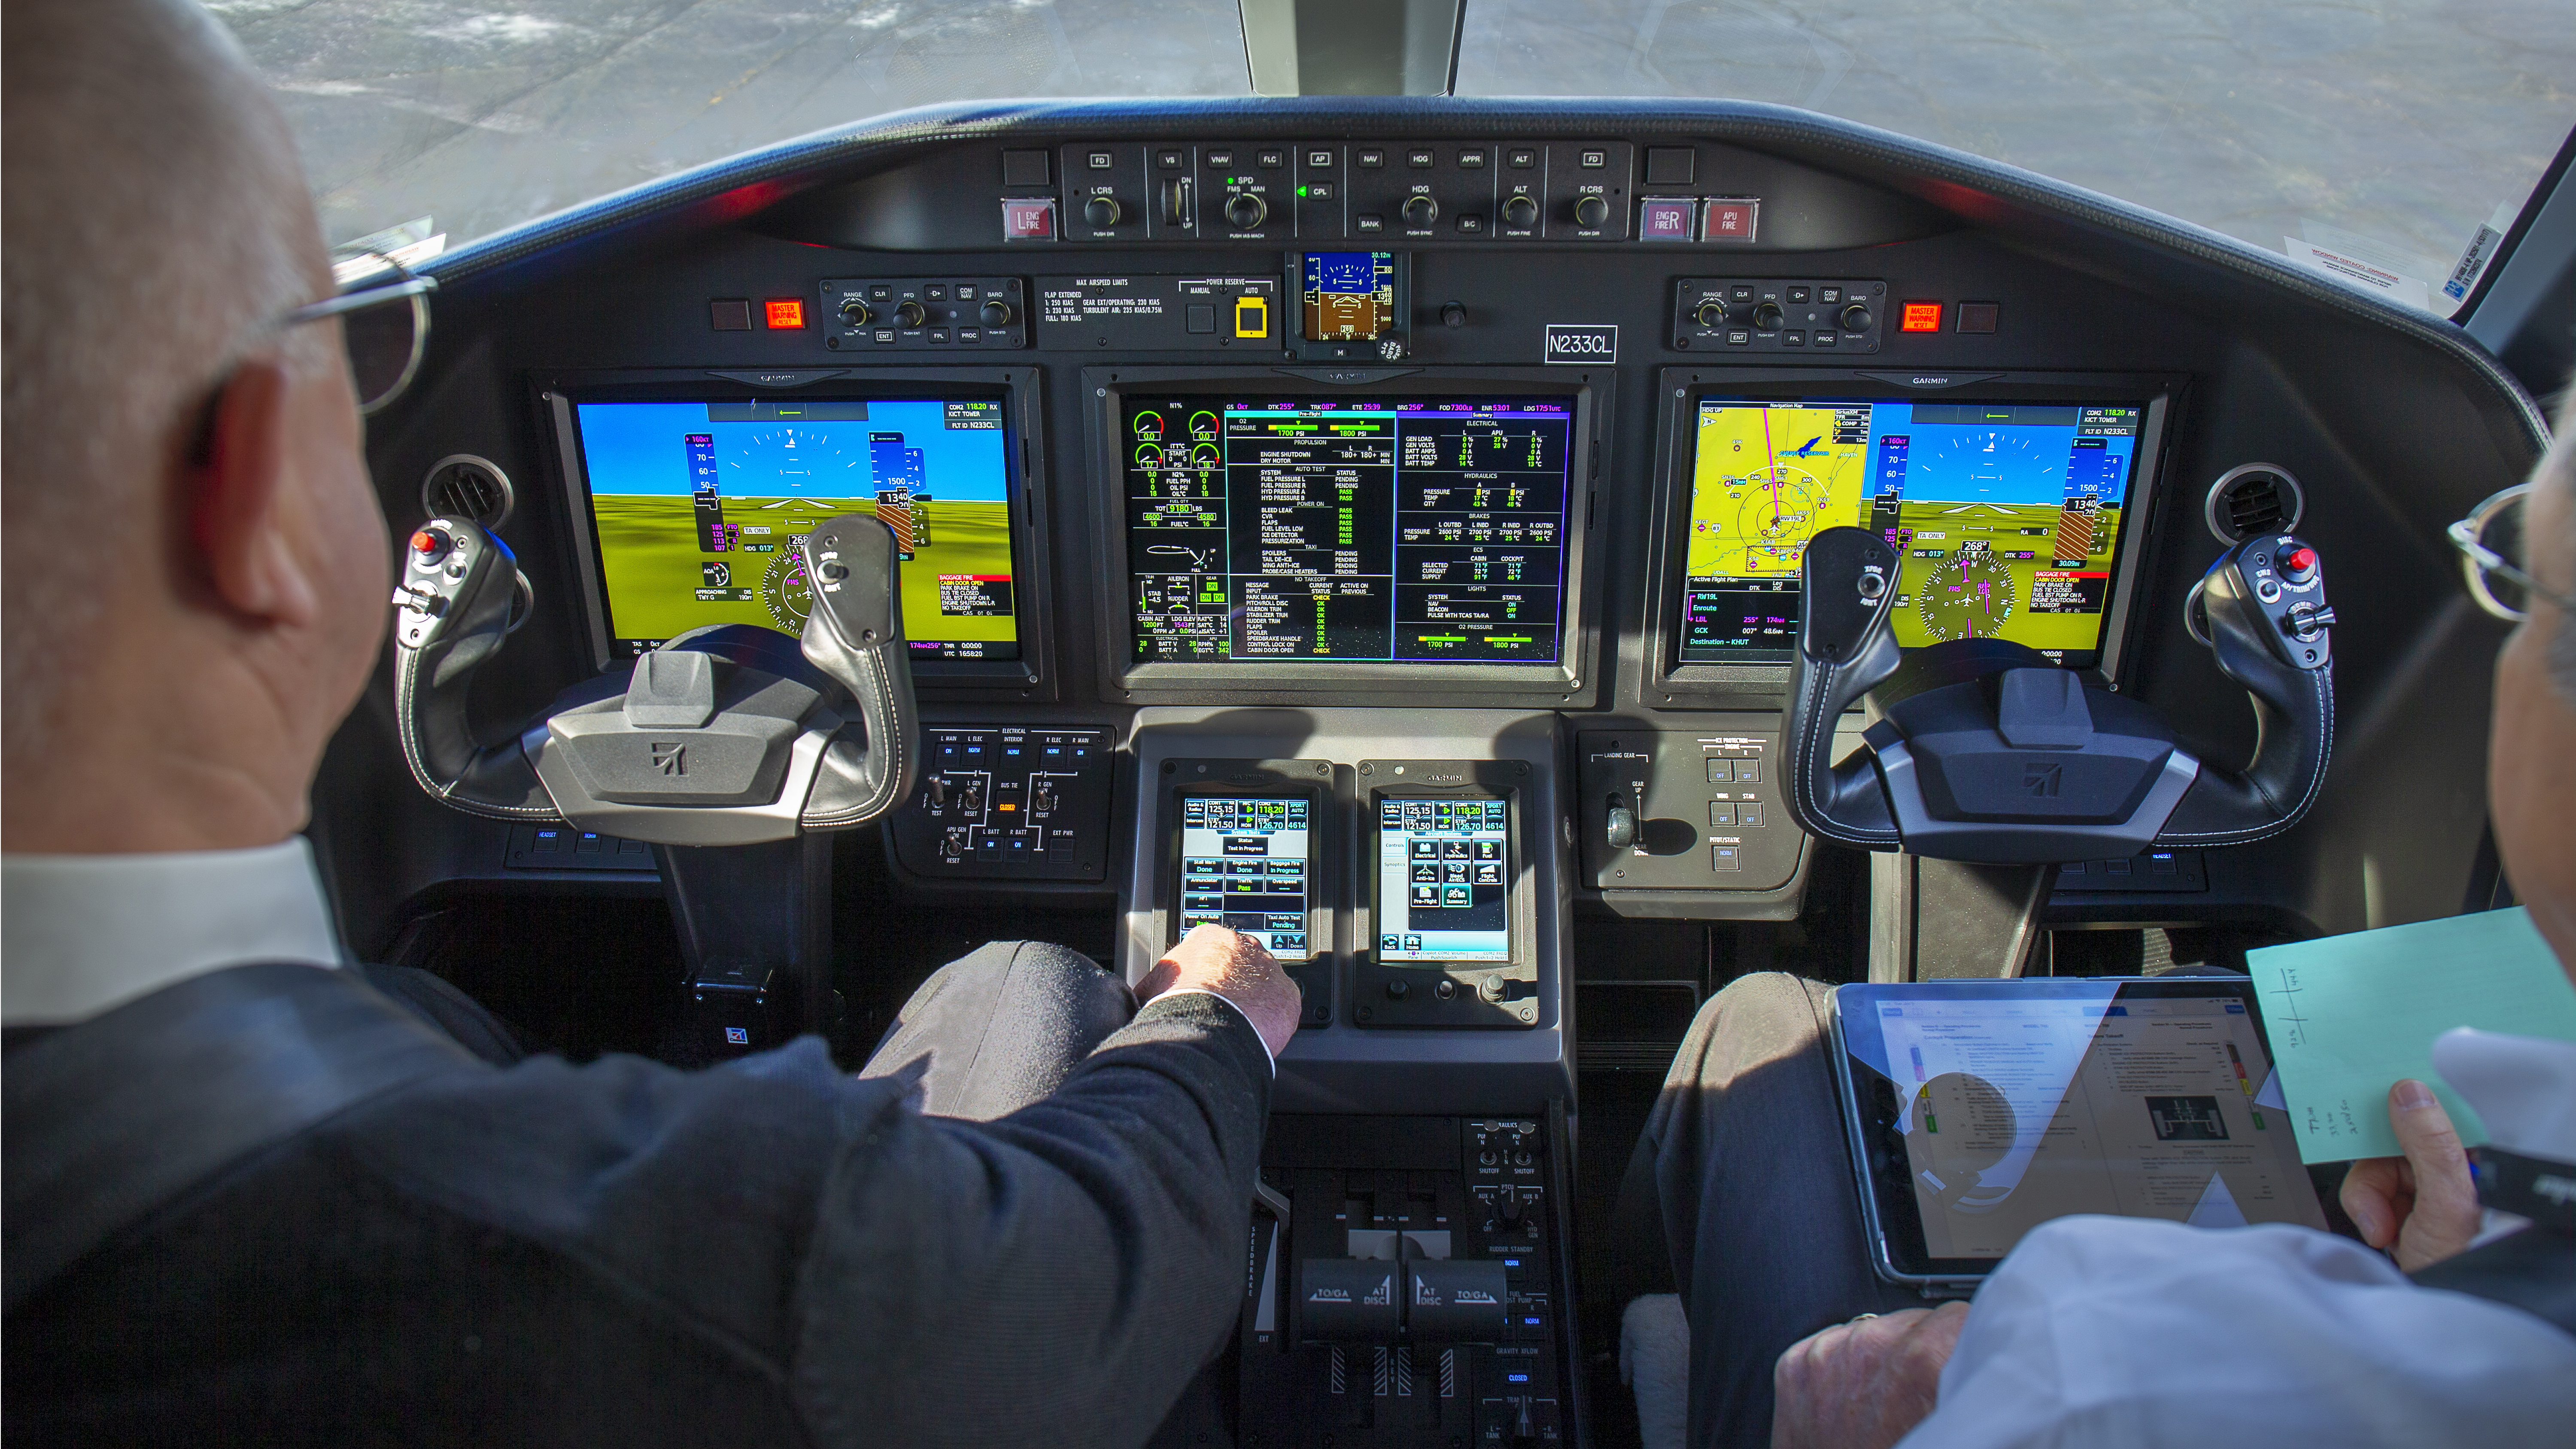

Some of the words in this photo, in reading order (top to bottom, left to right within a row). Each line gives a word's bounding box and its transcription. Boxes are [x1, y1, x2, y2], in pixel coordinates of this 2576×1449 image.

[1018, 213, 1025, 229] L
[1655, 221, 1669, 229] FIRE
[1669, 212, 1679, 229] R
[1386, 341, 1395, 358] BARO
[1550, 335, 1612, 352] N233CL
[1392, 344, 1400, 359] PUSH
[1965, 541, 1987, 550] 268°
[2256, 569, 2270, 577] CWS
[1318, 1289, 1349, 1297] TO/GA
[1364, 1297, 1385, 1305] DISC
